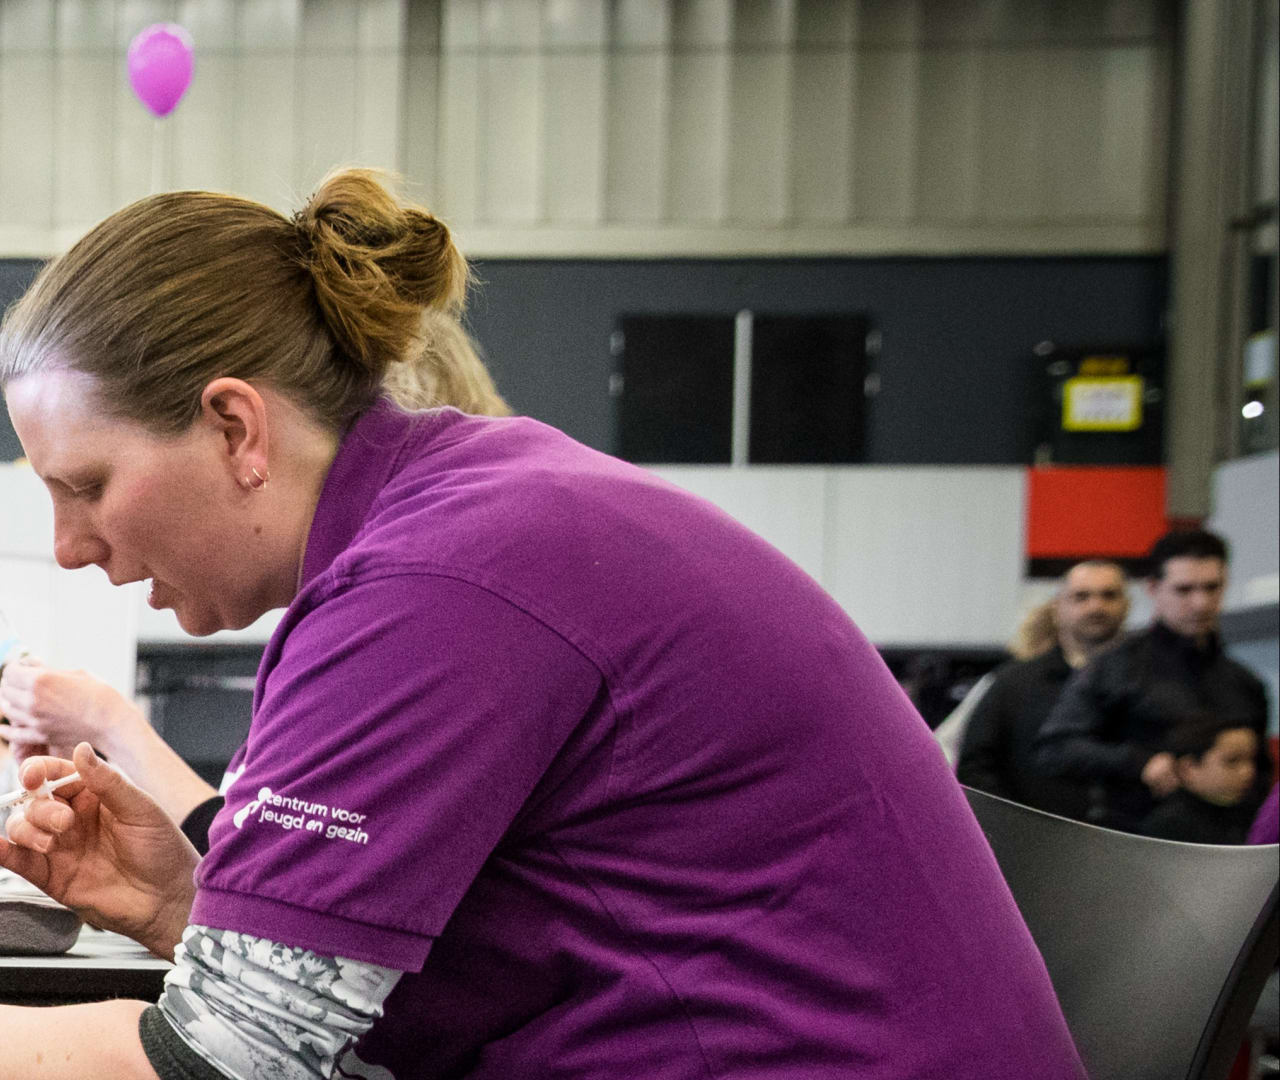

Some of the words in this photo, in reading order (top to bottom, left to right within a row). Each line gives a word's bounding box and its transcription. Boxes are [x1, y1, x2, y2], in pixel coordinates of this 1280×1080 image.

[259, 806, 305, 829] jeugd
[306, 819, 324, 832] en
[325, 825, 369, 844] gezin
[331, 806, 366, 824] voor
